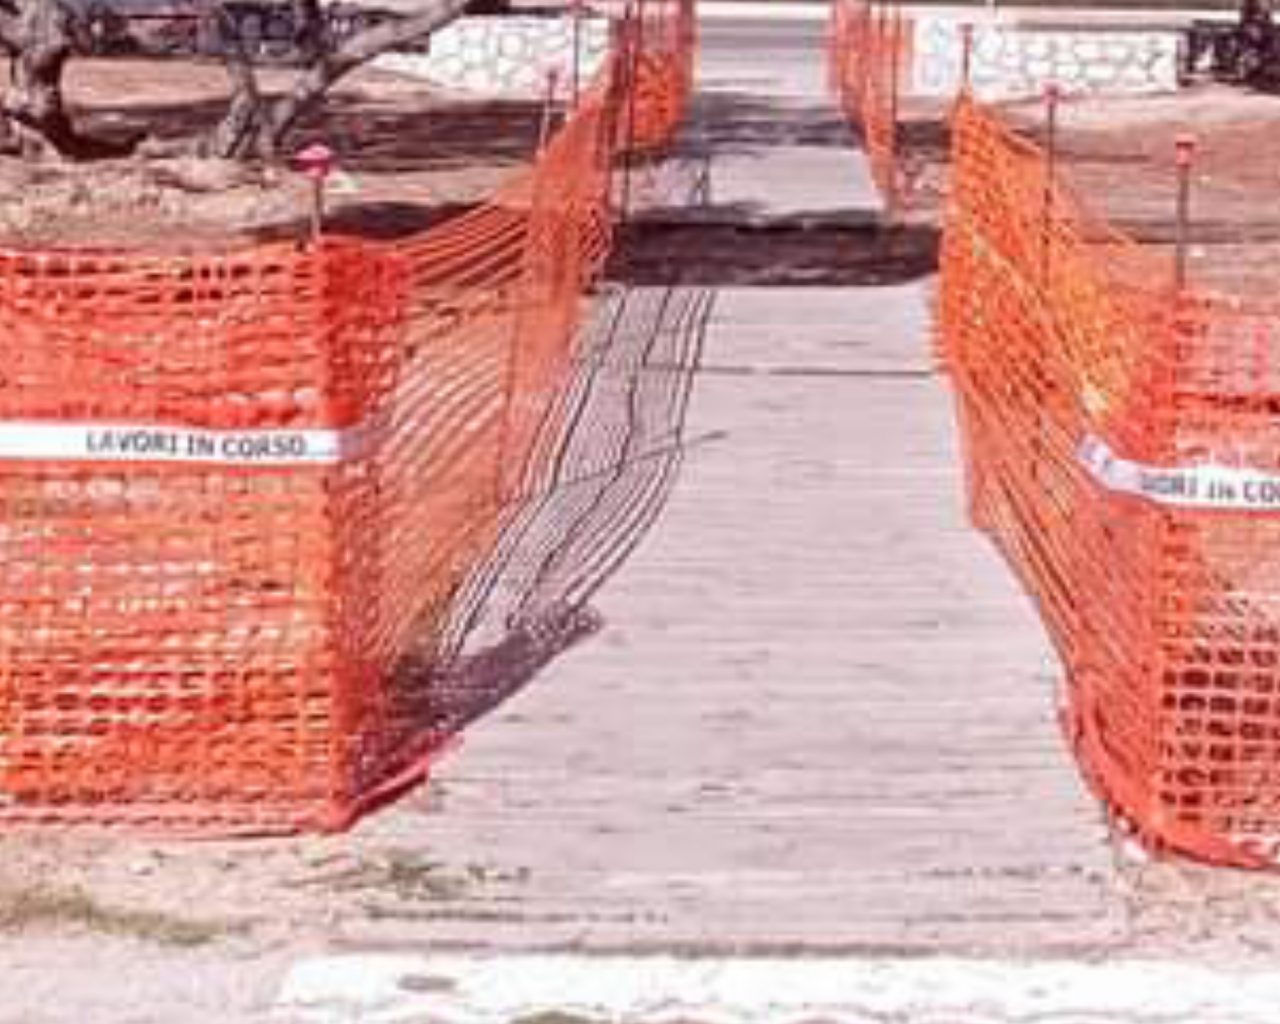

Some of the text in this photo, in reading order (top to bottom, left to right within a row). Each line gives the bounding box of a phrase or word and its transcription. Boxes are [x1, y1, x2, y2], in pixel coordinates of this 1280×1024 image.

[85, 429, 307, 458] LAVORI IN CORSO
